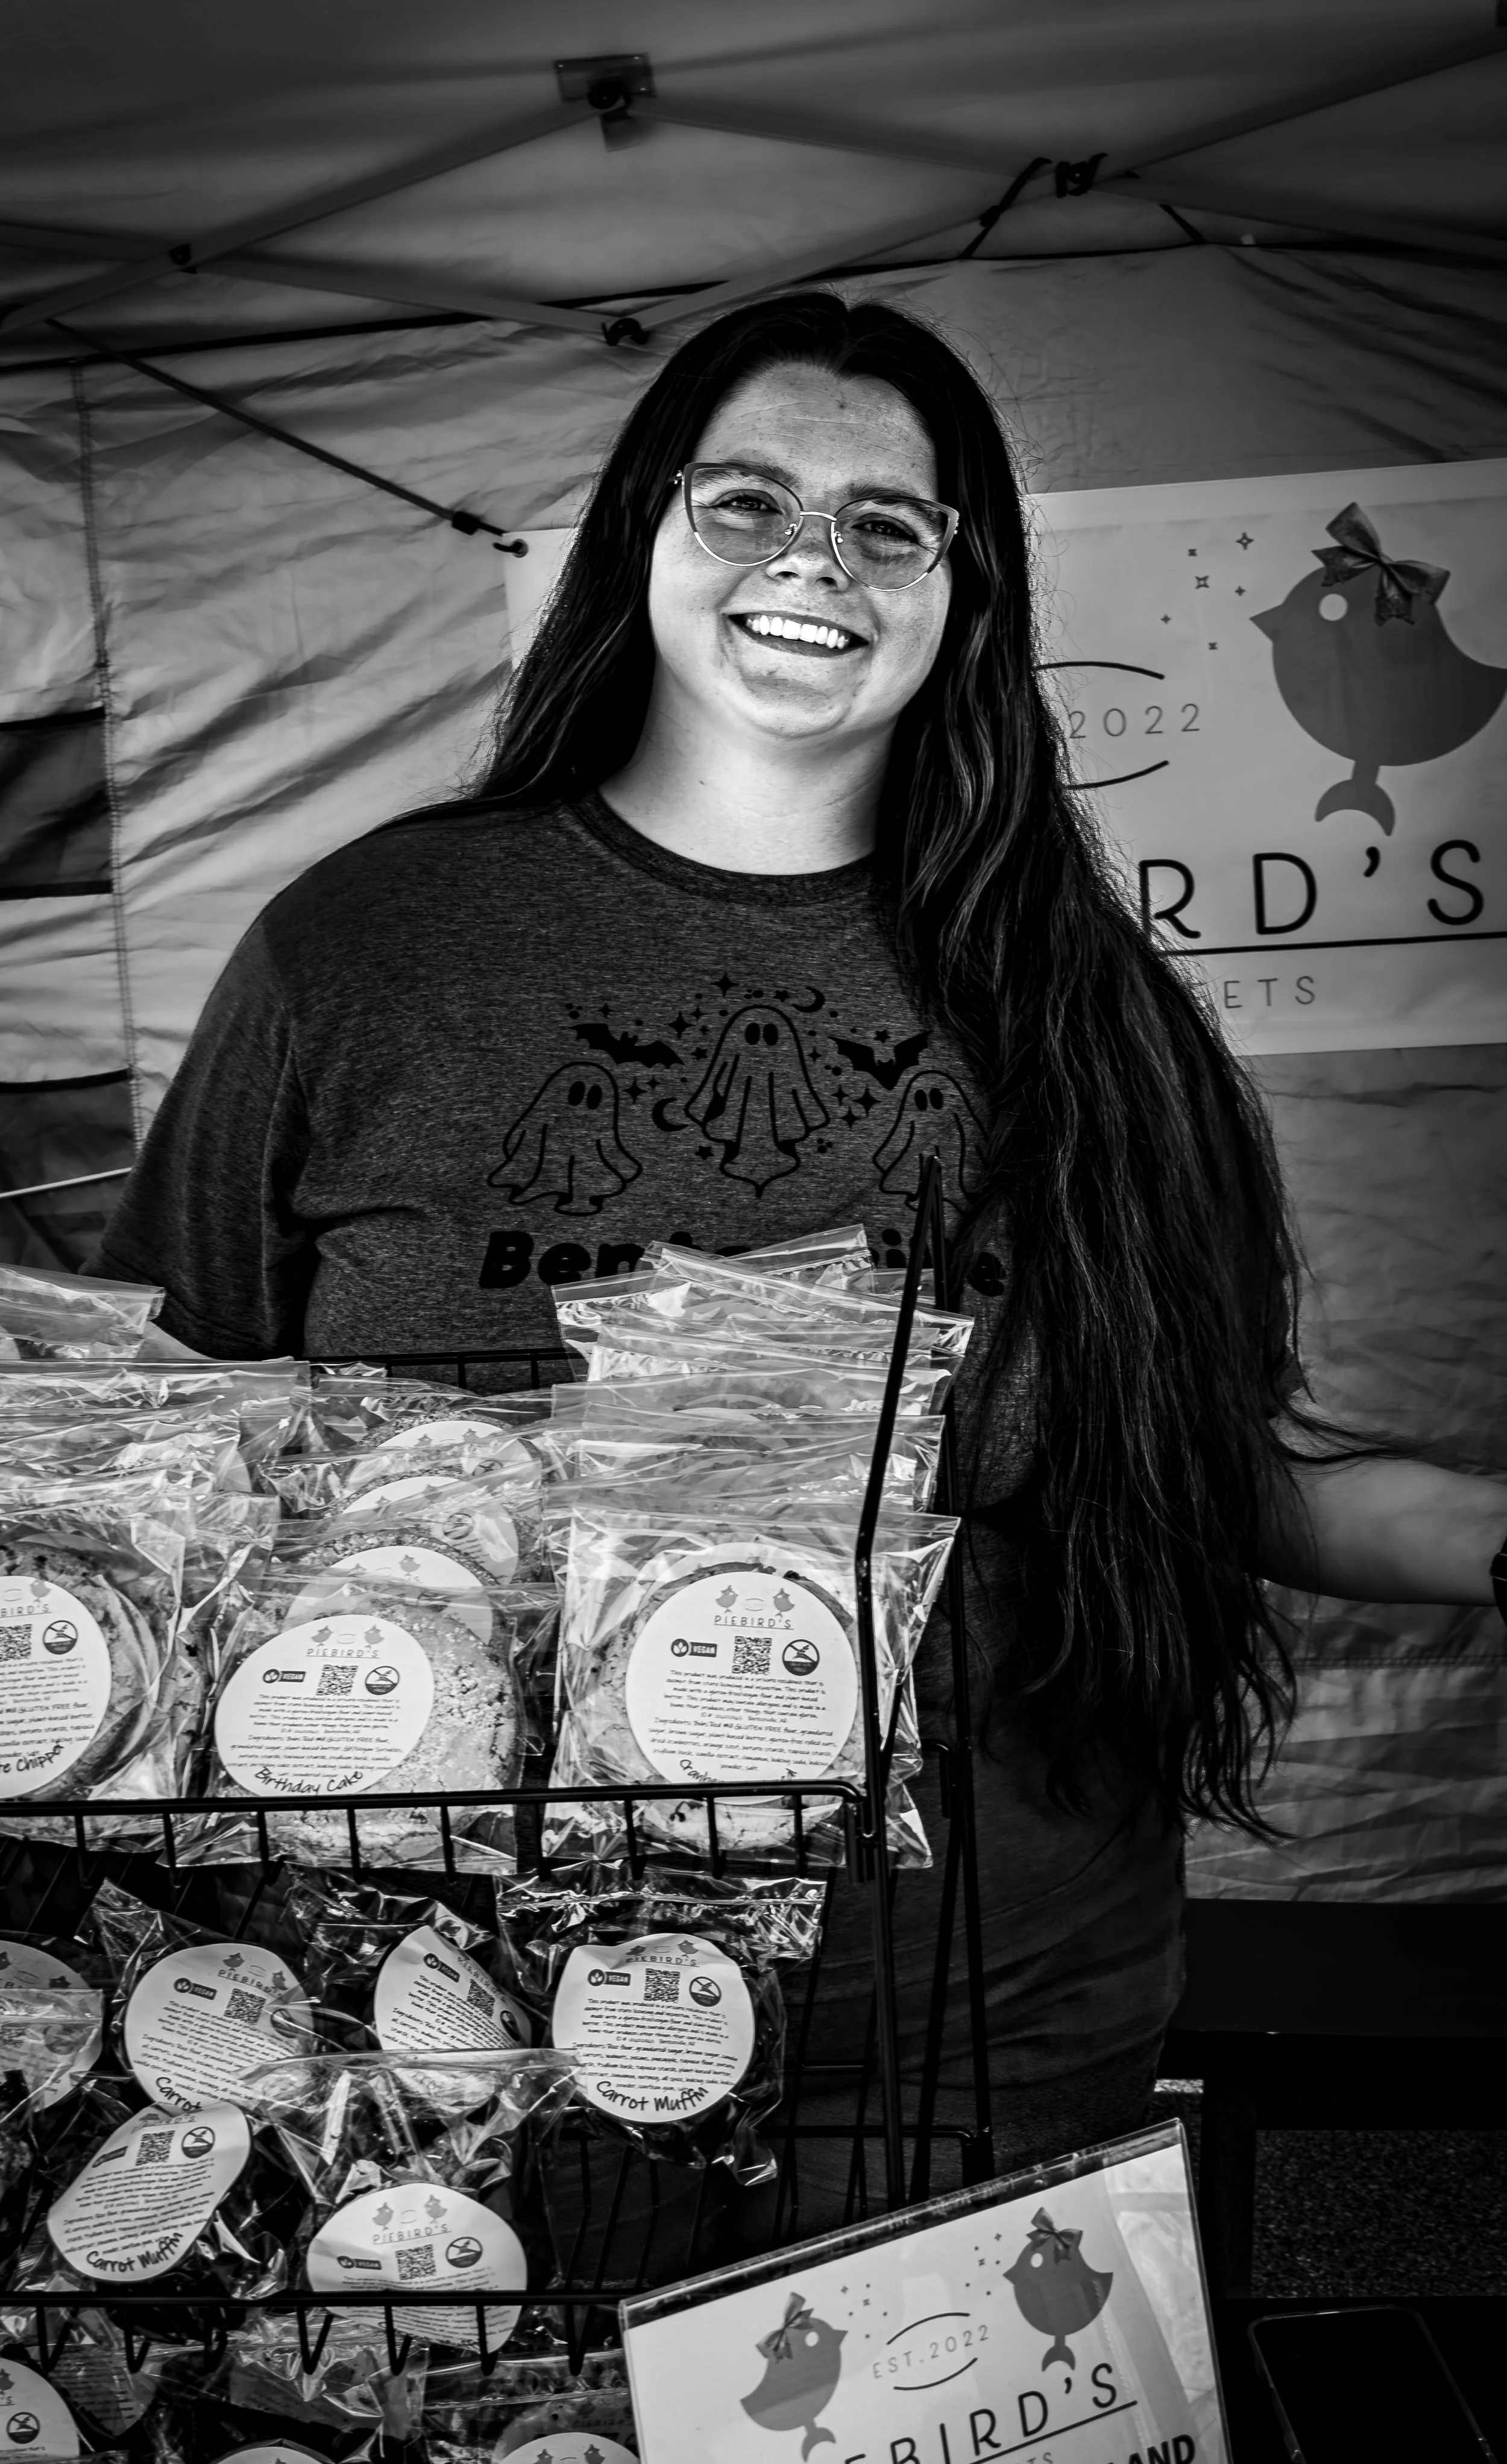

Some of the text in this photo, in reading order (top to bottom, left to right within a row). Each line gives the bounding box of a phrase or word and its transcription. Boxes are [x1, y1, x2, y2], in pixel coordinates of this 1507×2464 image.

[714, 1615, 792, 1629] PIEBIRD'S
[596, 2081, 649, 2111] Carrot
[86, 2251, 136, 2272] Carrot
[845, 2362, 1118, 2464] BIRD'S
